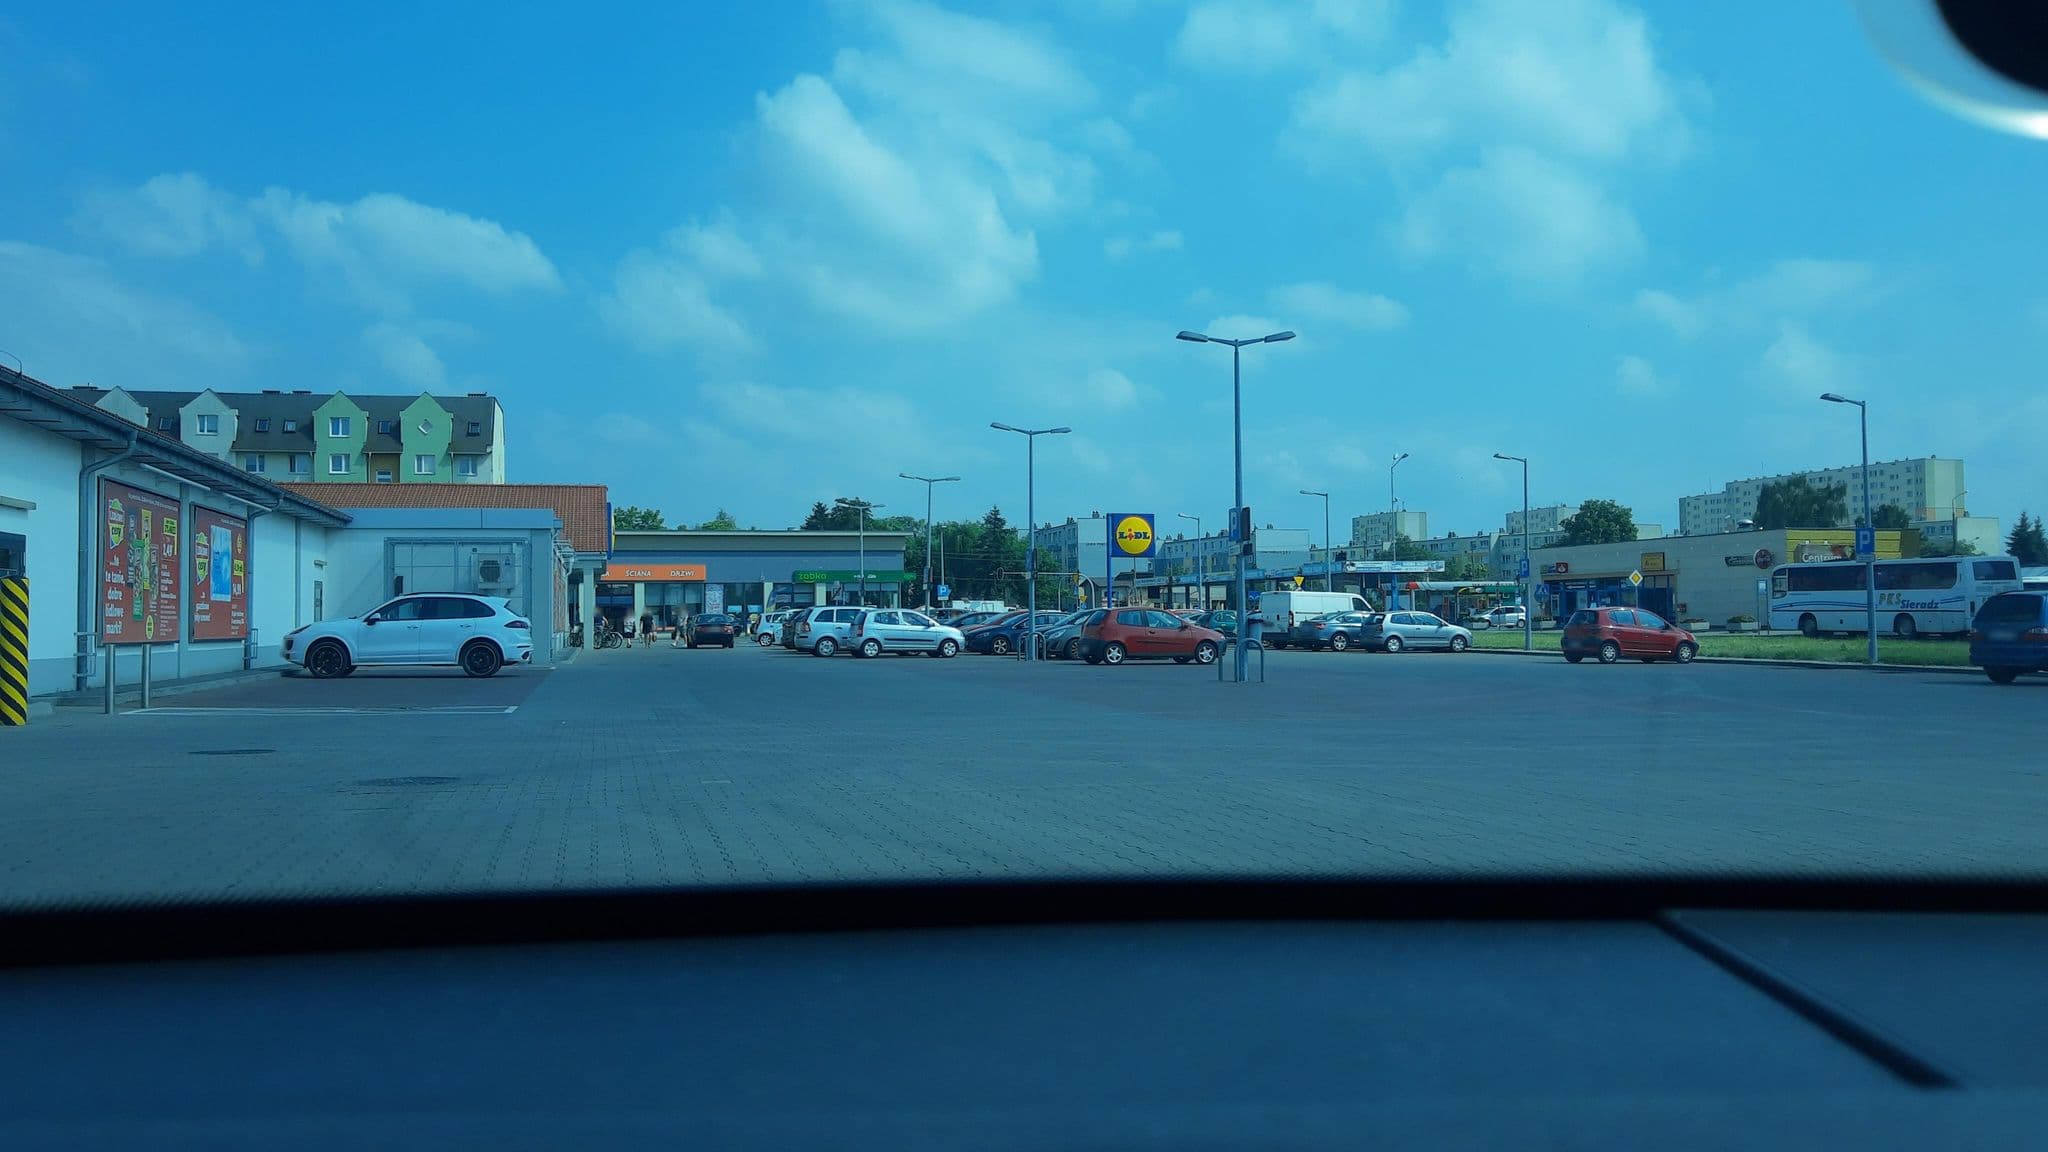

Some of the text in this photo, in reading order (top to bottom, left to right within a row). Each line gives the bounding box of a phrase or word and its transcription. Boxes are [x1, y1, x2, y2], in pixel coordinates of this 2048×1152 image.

[1860, 530, 1870, 551] P
[1521, 561, 1527, 576] P
[940, 586, 947, 596] P
[1879, 592, 1940, 609] PKS Sieradz
